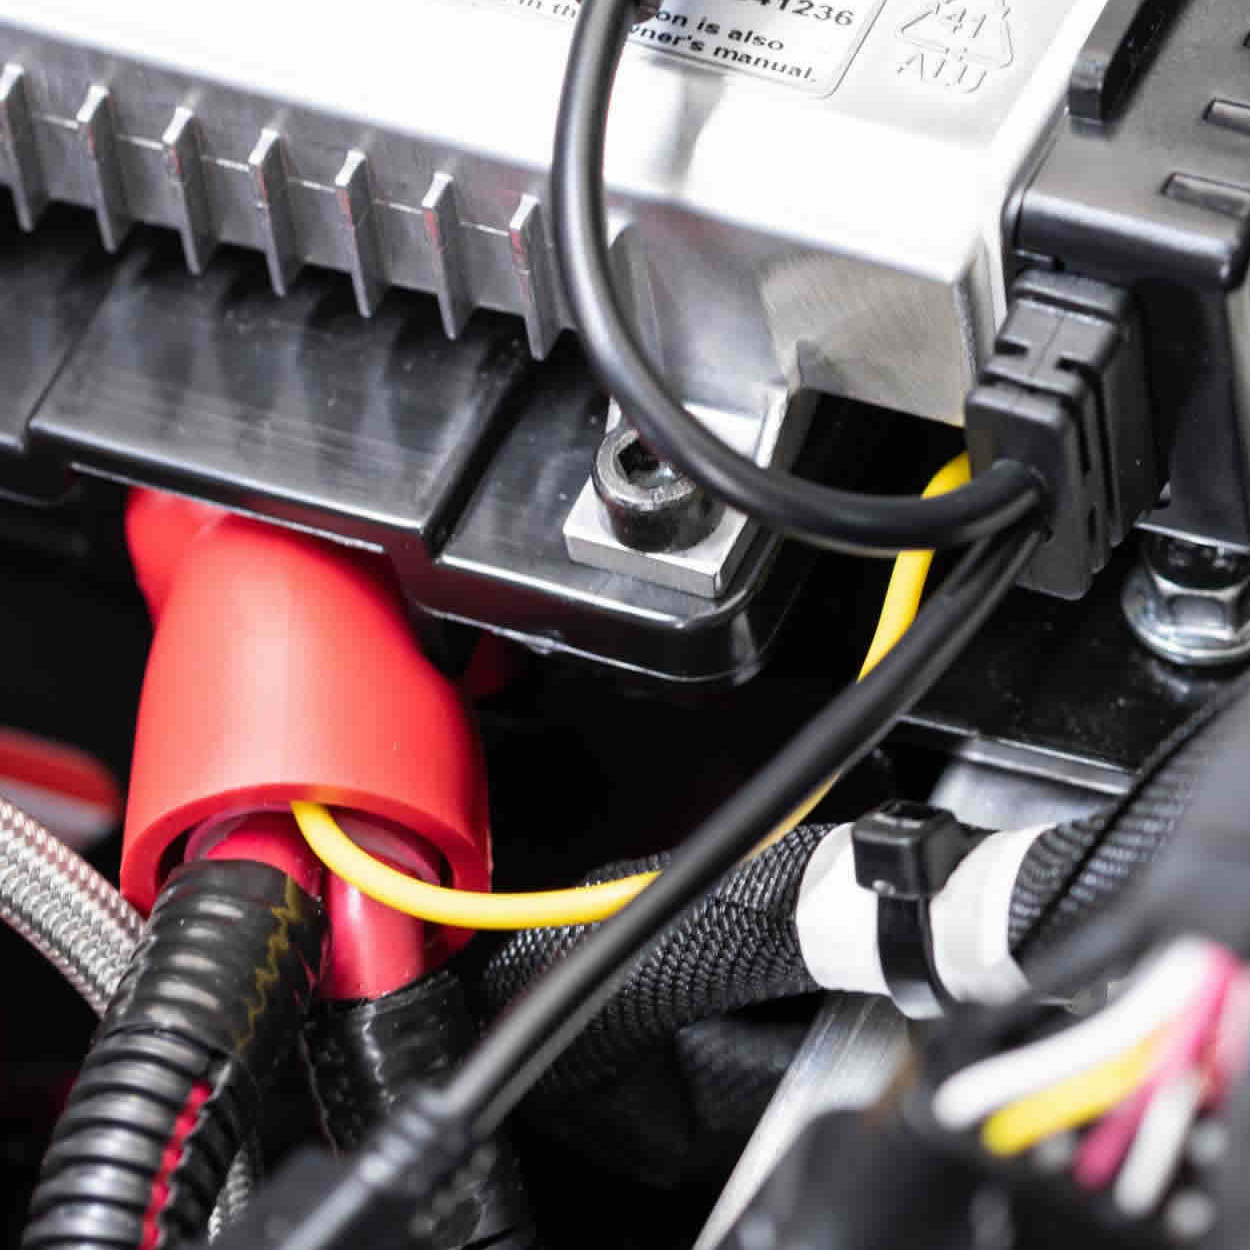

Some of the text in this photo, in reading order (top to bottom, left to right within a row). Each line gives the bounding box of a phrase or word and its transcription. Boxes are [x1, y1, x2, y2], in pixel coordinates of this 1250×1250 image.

[552, 2, 577, 19] th
[655, 8, 784, 51] on is also
[712, 44, 817, 83] manual.
